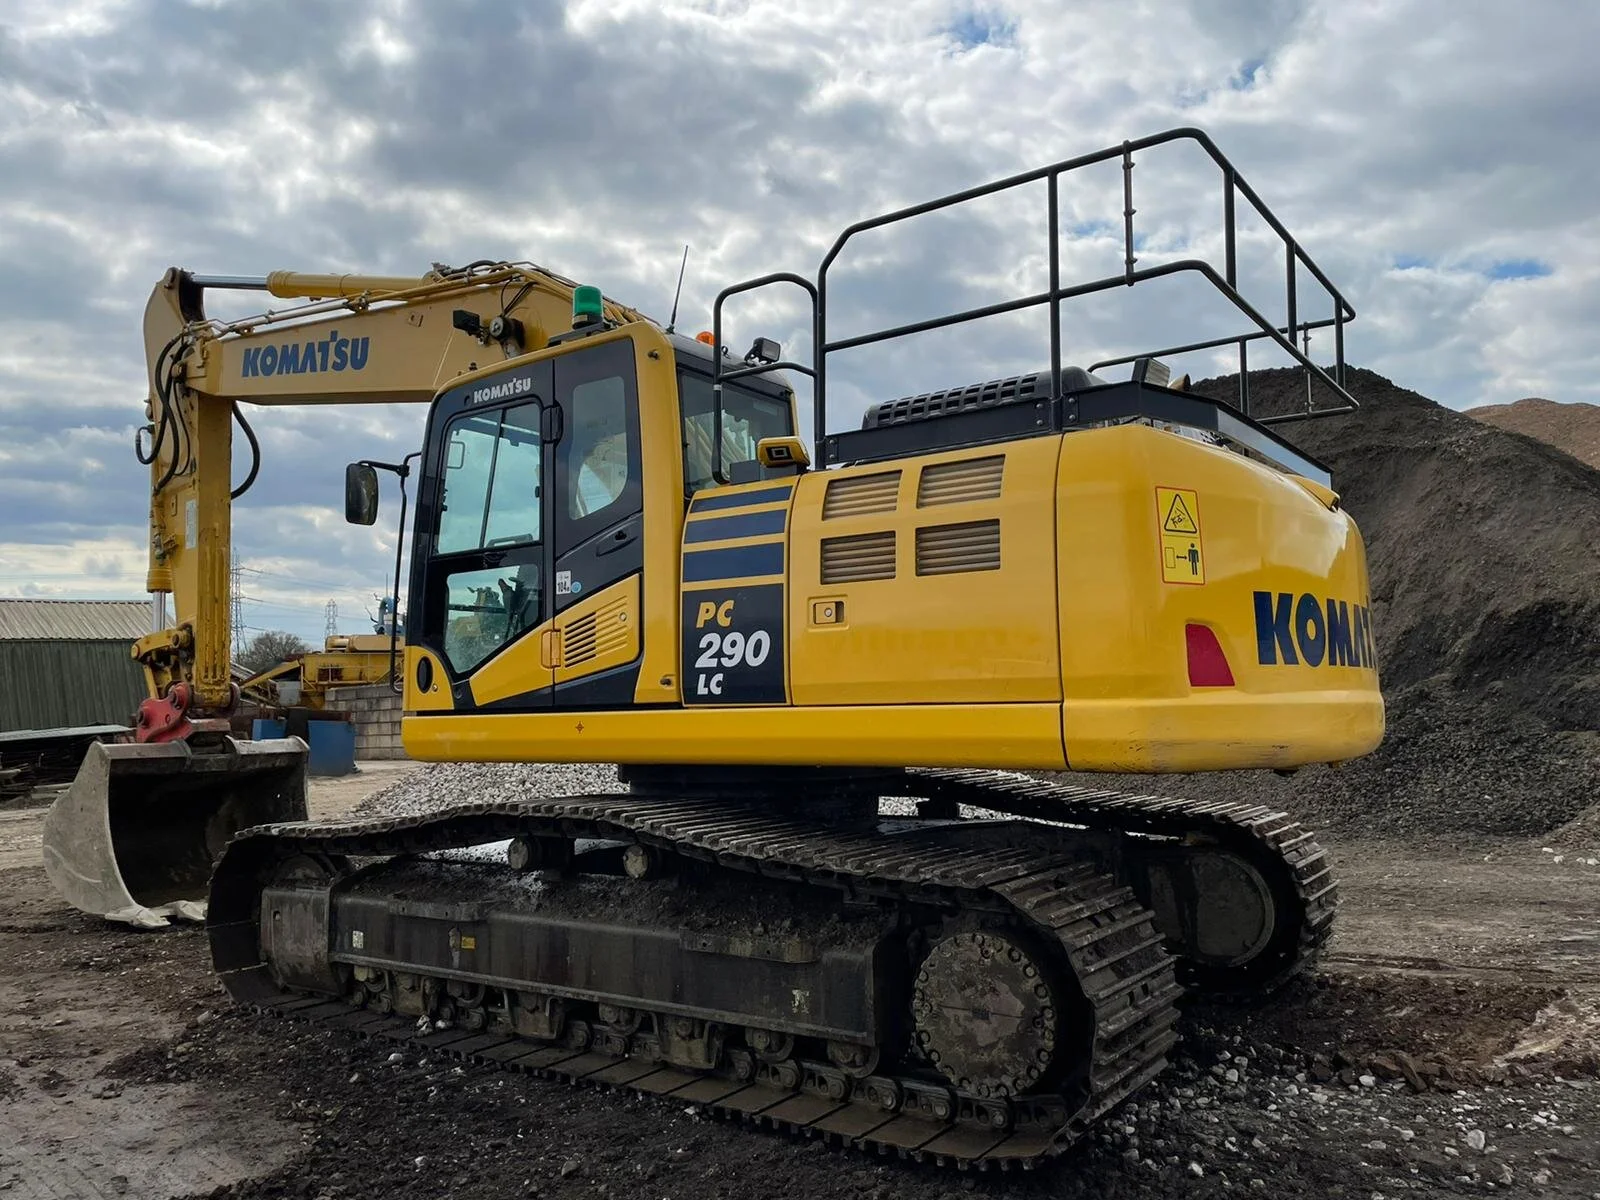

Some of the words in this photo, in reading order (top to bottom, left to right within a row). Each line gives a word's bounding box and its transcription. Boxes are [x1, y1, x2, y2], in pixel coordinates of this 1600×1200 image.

[241, 330, 370, 377] KOMATSU
[474, 378, 531, 403] KOMATSU
[696, 600, 734, 628] PC
[1253, 591, 1376, 668] KOMAT
[695, 630, 771, 668] 290
[697, 673, 724, 695] LC
